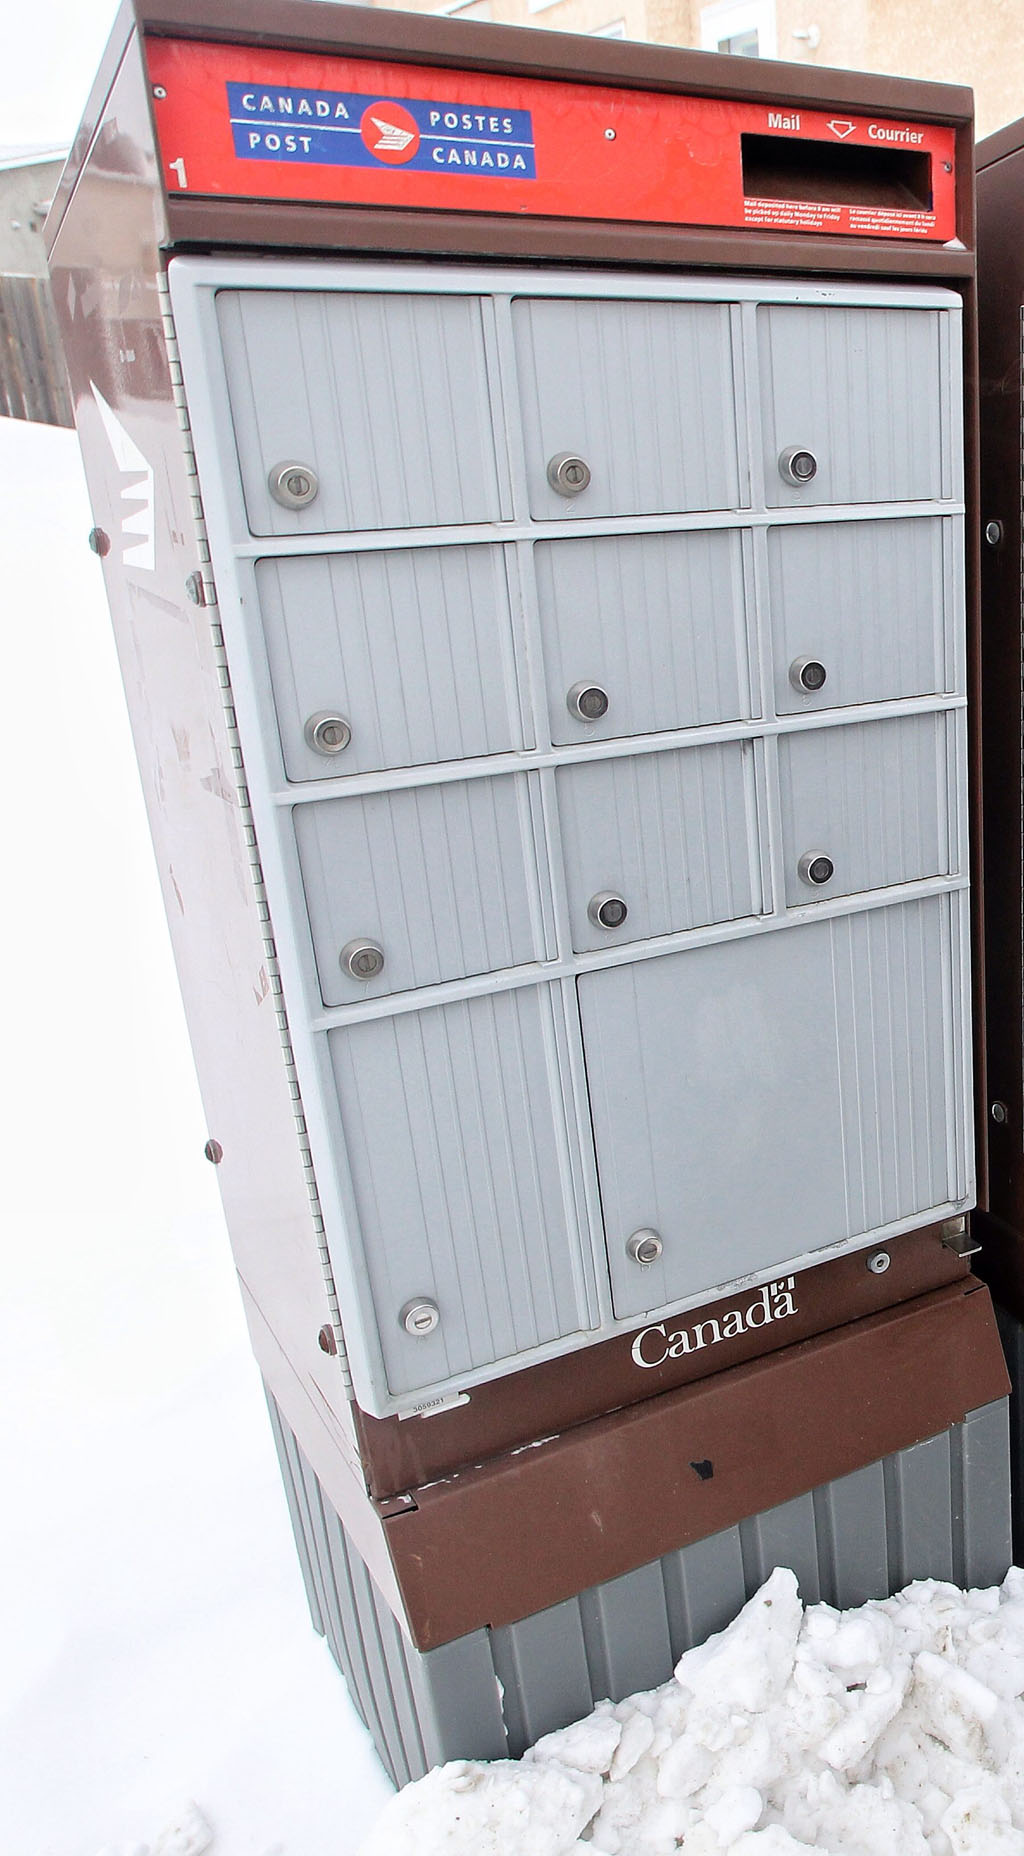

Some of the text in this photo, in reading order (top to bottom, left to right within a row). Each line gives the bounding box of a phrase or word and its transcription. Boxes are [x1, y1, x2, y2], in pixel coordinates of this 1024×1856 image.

[241, 94, 350, 119] CANADA
[429, 110, 513, 134] POSTES
[767, 112, 924, 144] Mail Courrier
[248, 132, 312, 153] POST
[432, 147, 527, 170] CANADA
[169, 157, 188, 189] 1
[631, 1284, 799, 1369] Canada
